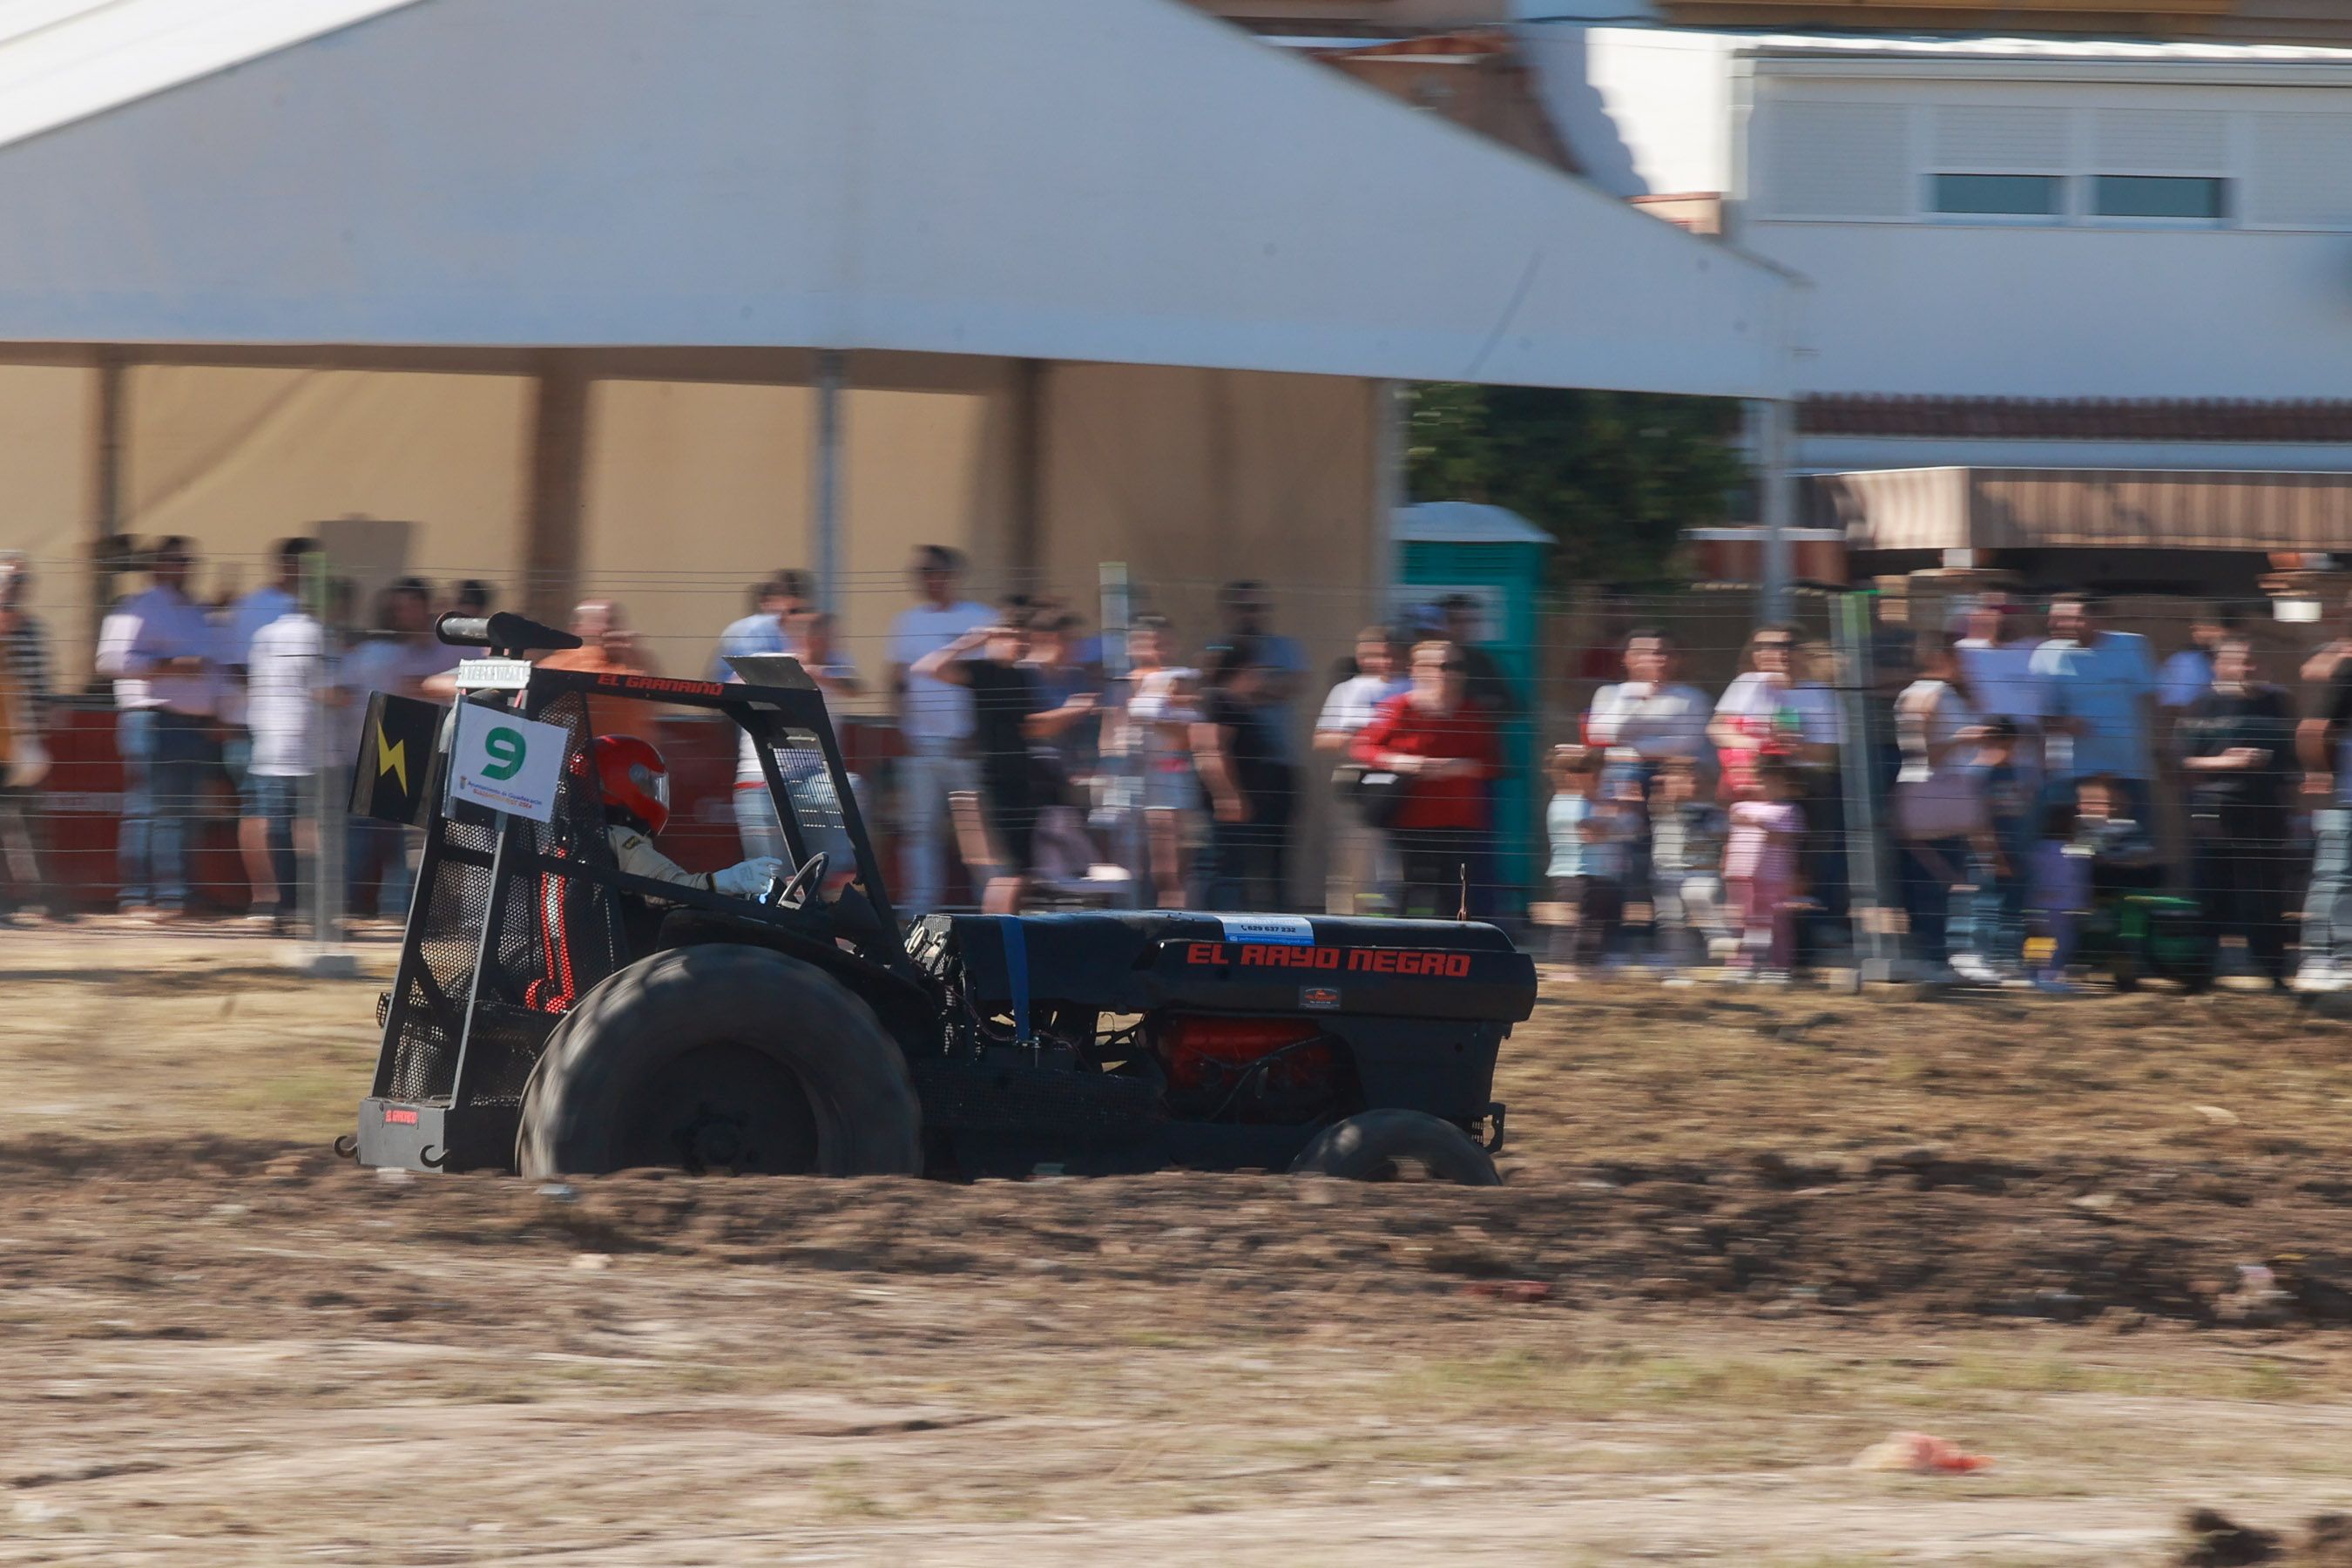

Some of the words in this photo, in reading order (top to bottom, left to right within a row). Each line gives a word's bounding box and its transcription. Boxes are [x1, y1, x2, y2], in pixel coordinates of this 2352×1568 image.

[598, 673, 620, 686] EL
[480, 727, 526, 781] 9
[1186, 943, 1228, 964] EL
[1240, 944, 1341, 970] RAYO
[1348, 949, 1472, 977] NEGRO
